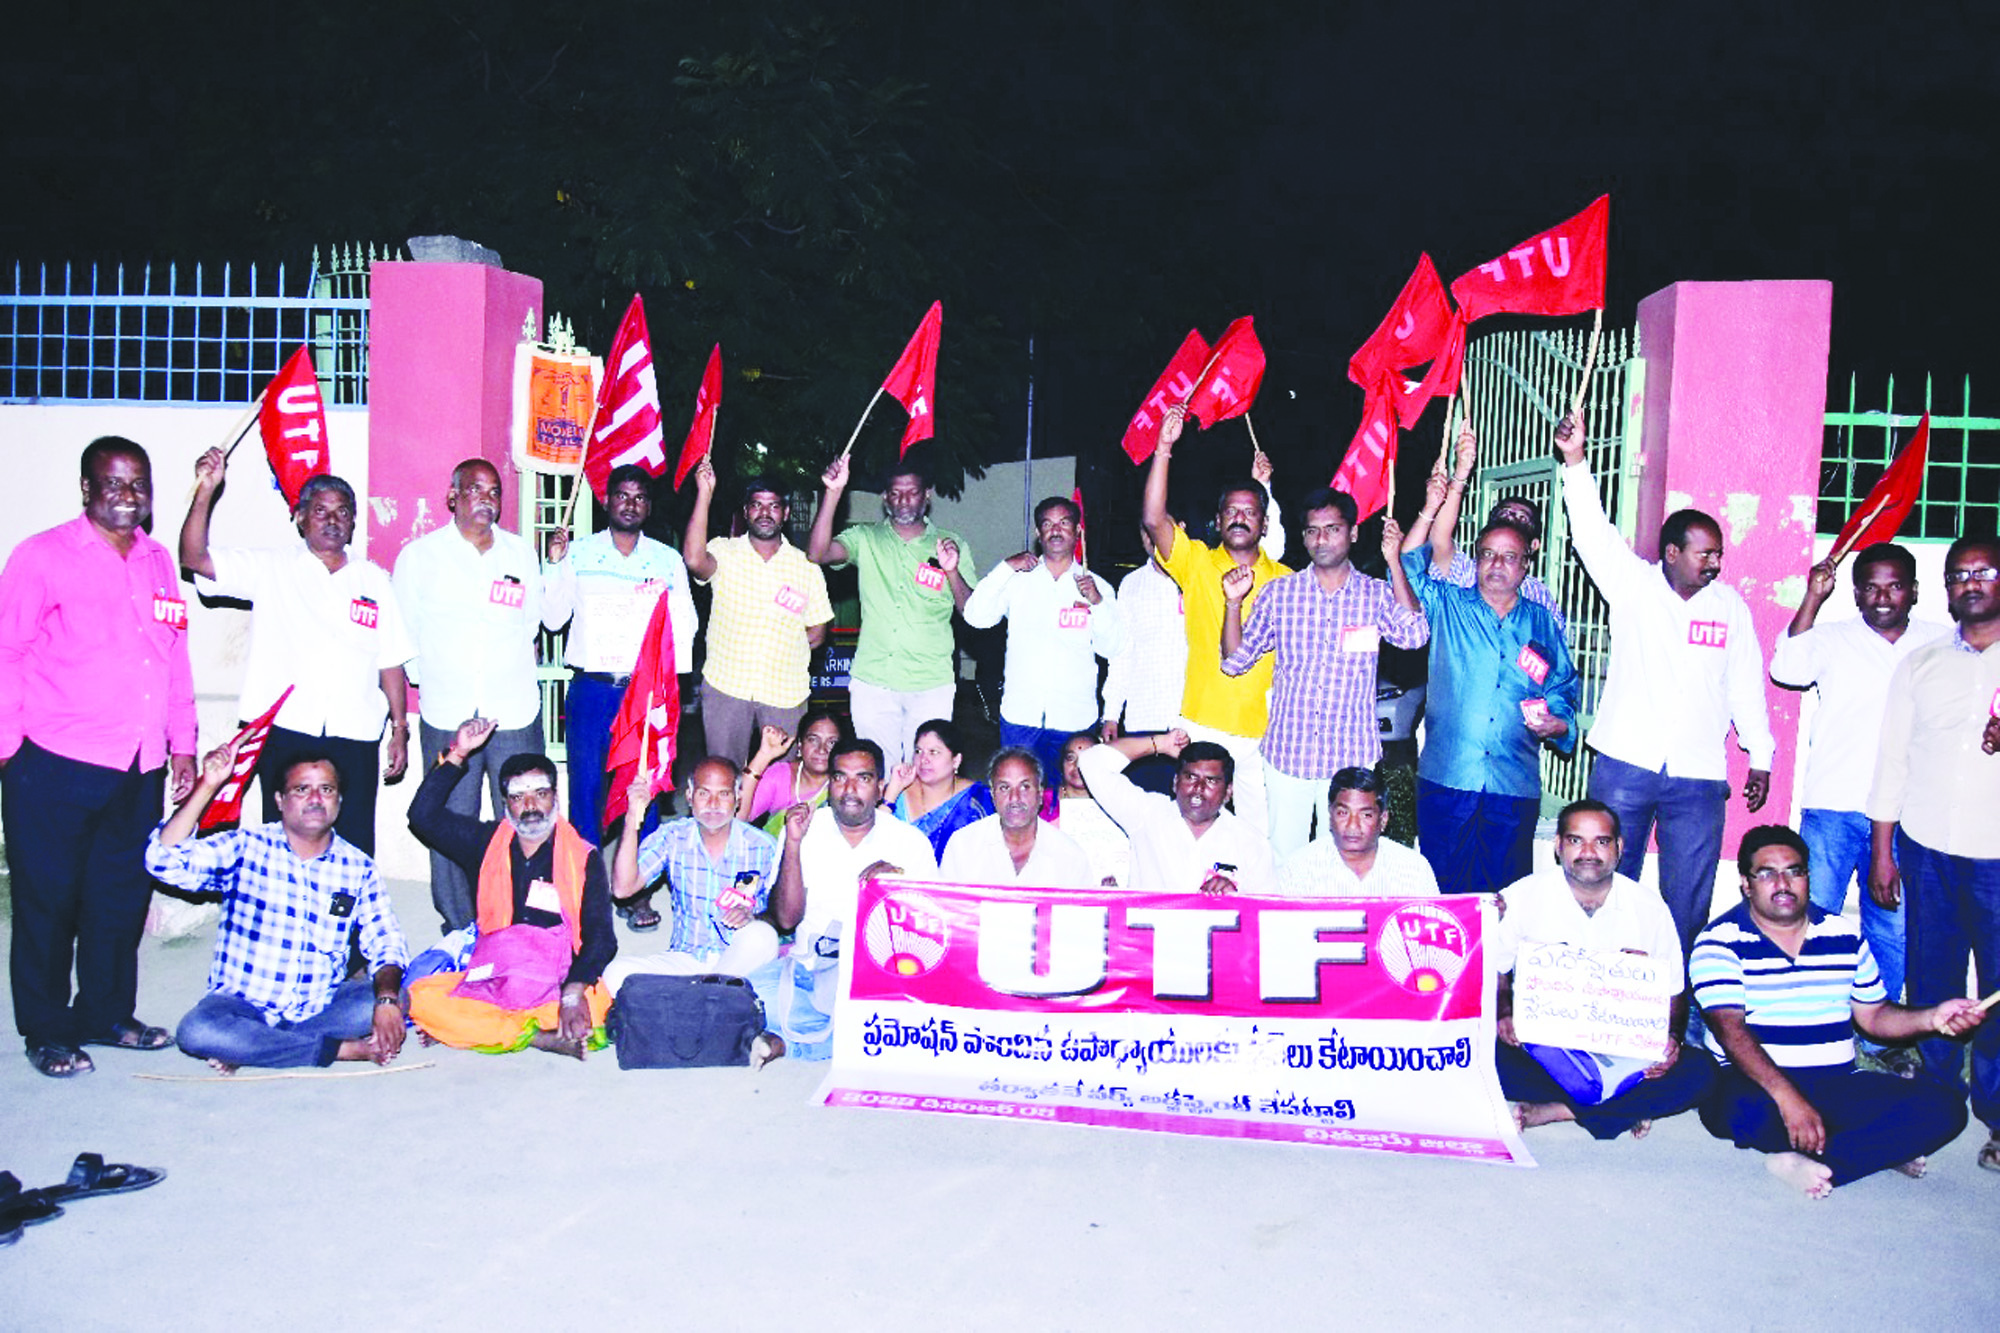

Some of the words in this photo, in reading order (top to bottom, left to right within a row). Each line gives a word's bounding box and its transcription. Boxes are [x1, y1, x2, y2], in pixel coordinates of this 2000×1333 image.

[277, 384, 320, 469] UTF
[918, 566, 944, 588] UTF
[492, 586, 522, 605] UTF
[778, 589, 802, 611] UTF
[154, 599, 185, 624] UTF
[352, 602, 377, 627] UTF
[1691, 624, 1726, 646] UTF
[1521, 651, 1545, 680] UTF
[889, 905, 940, 934] UTF
[1402, 919, 1458, 945] UTF
[977, 899, 1368, 1004] UTF
[863, 1012, 958, 1057] ప్రమోషన్
[1319, 1027, 1471, 1071] కేటాయించాలి
[1591, 1032, 1623, 1046] UTF
